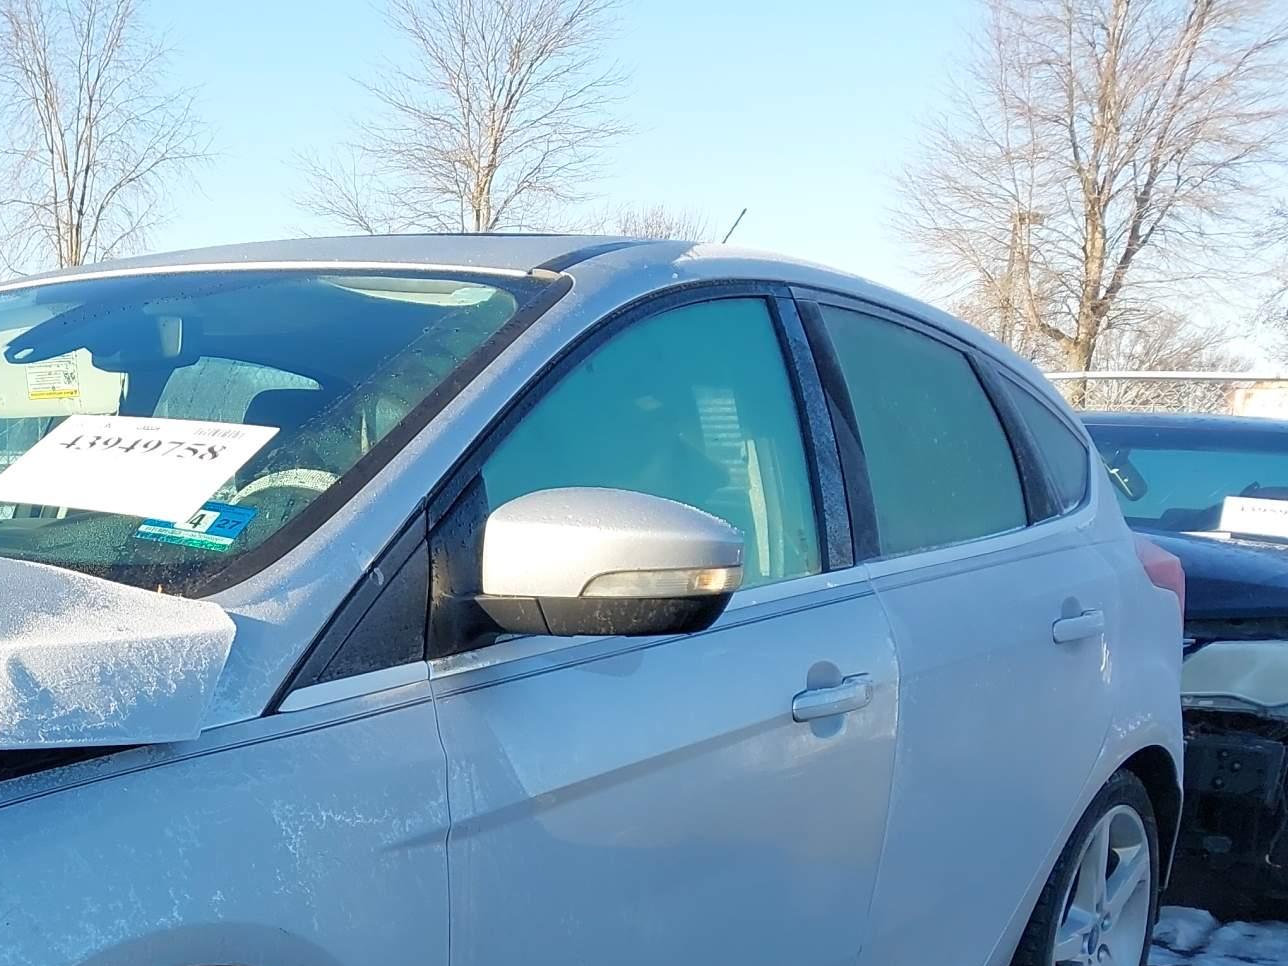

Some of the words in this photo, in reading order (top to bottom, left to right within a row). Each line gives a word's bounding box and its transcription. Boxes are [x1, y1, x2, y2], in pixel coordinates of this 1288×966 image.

[59, 434, 227, 461] 43949758
[189, 513, 207, 529] 4
[215, 518, 242, 530] 27
